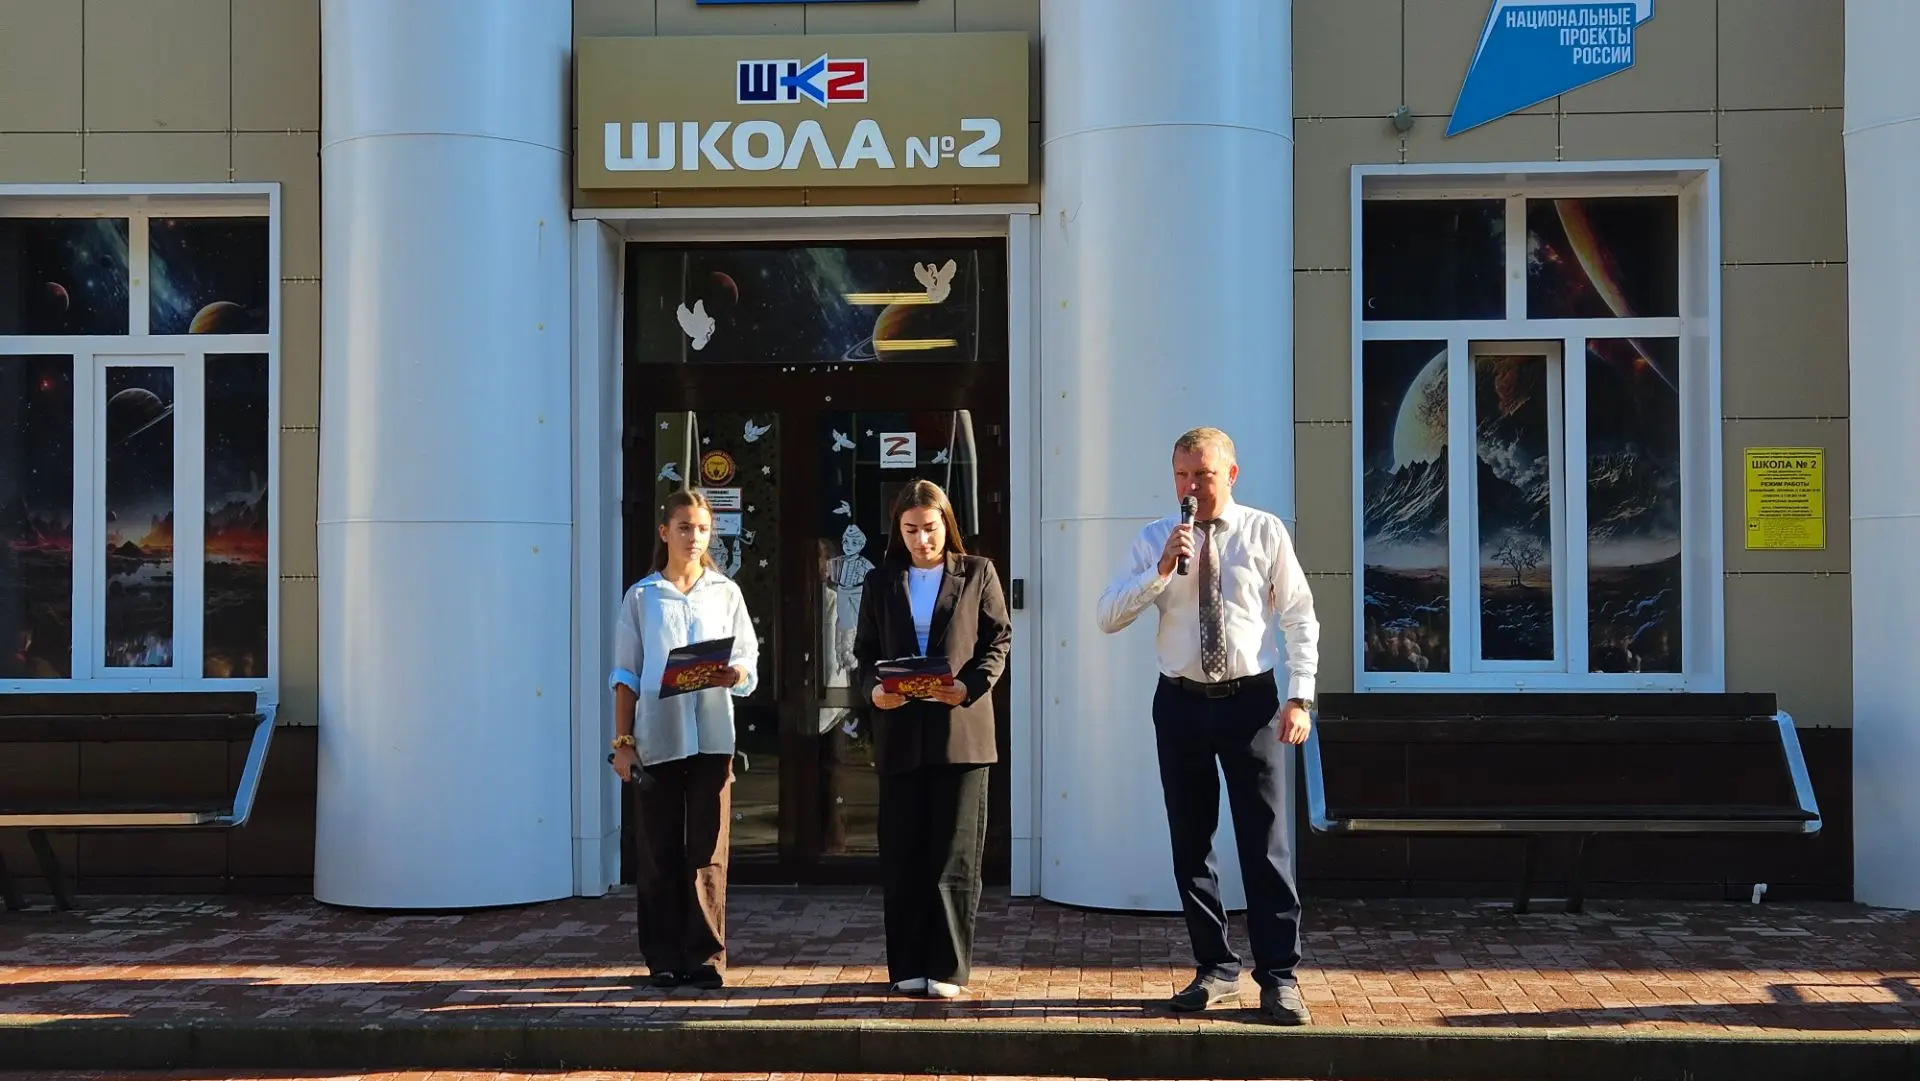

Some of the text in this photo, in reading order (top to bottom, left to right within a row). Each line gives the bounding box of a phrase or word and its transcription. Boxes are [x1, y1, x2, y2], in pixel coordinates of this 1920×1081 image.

[1505, 7, 1631, 29] НАЦИОНАЛЬНЫЕ
[1559, 27, 1631, 46] ПРОЕКТЫ
[1572, 46, 1631, 65] РОССИИ
[604, 119, 896, 171] ШКОЛА
[883, 436, 913, 457] Z
[1752, 460, 1817, 469] ШКОЛА № 2
